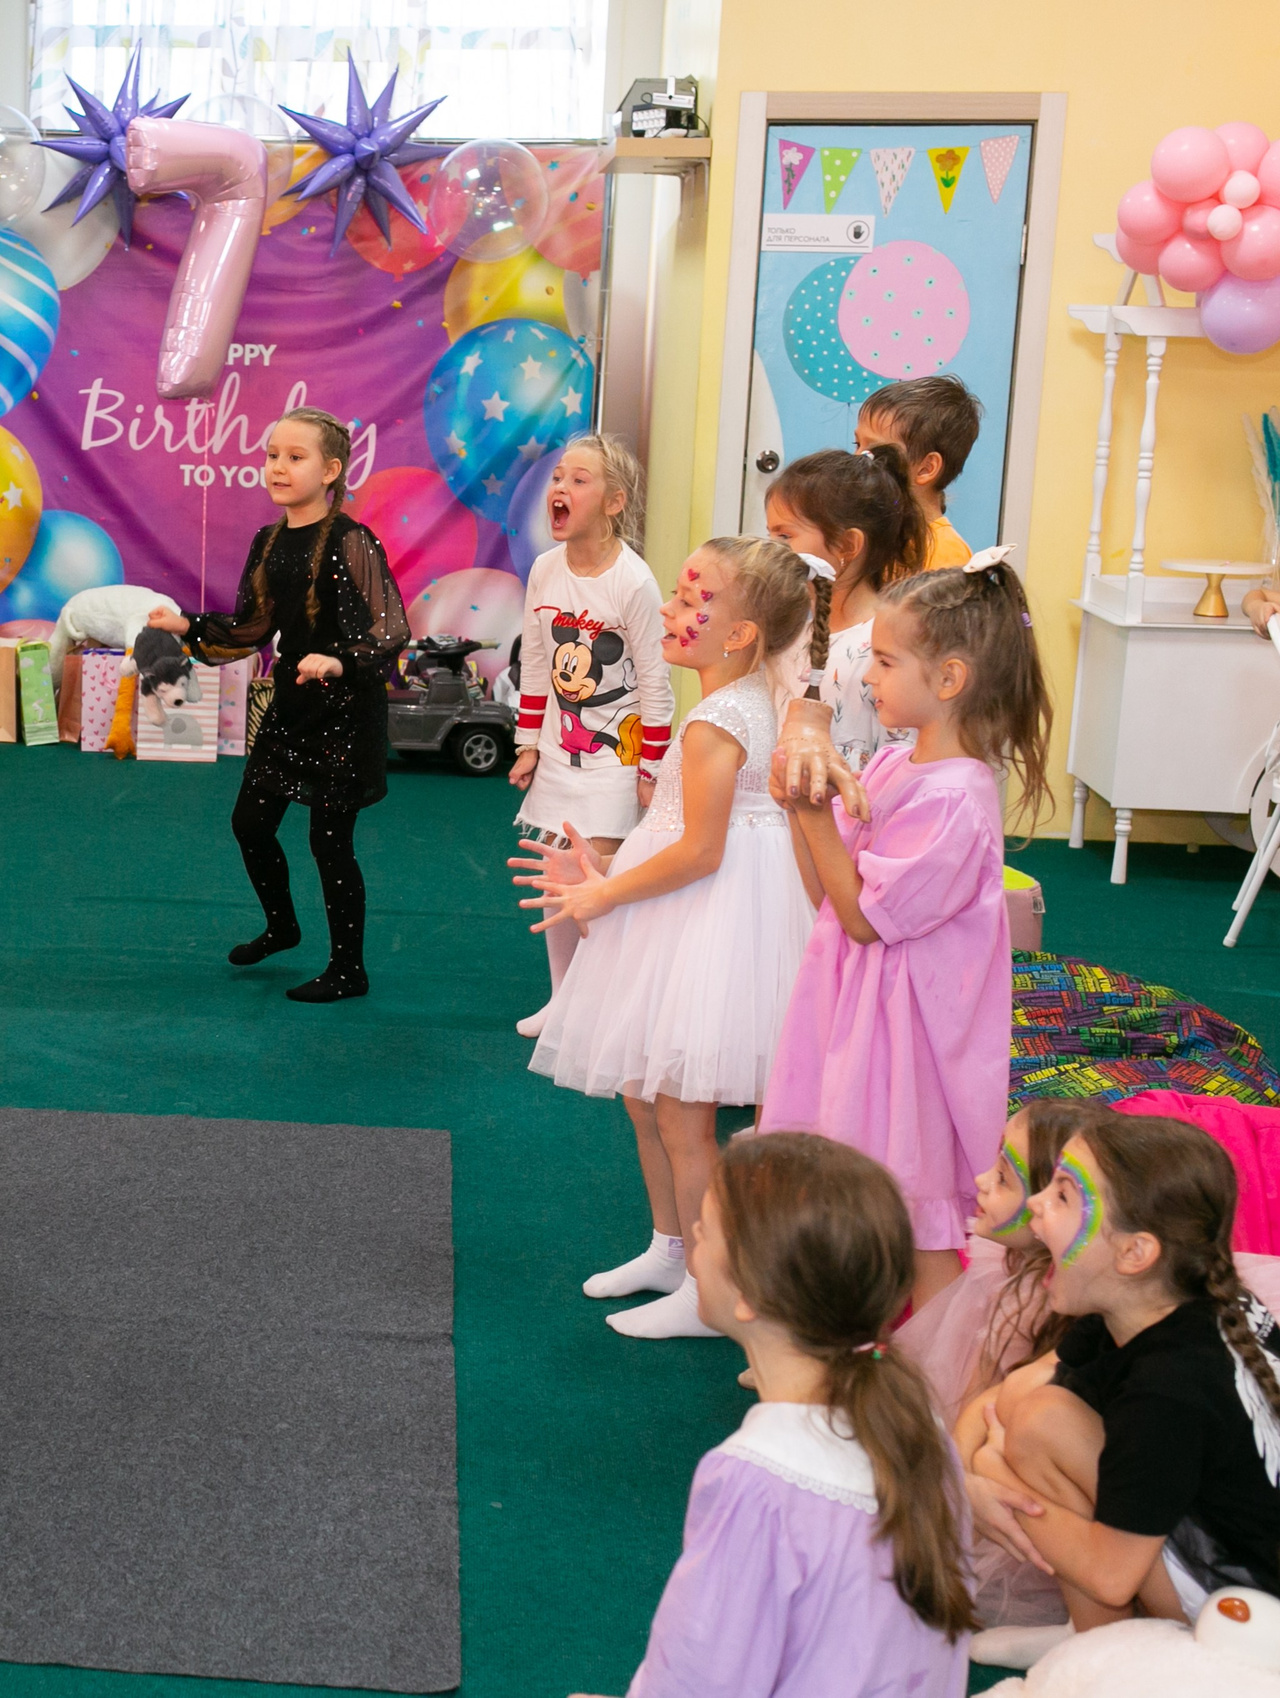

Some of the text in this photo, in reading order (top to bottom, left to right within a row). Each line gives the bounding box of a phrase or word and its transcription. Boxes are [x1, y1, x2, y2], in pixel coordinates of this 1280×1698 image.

[784, 235, 831, 243] ПЕРСОНАЛА
[125, 116, 268, 400] 7
[225, 343, 277, 366] PPY
[180, 464, 216, 487] TO
[1012, 965, 1041, 973] THANK
[1022, 1066, 1059, 1084] THANK
[1057, 1063, 1080, 1072] YOU
